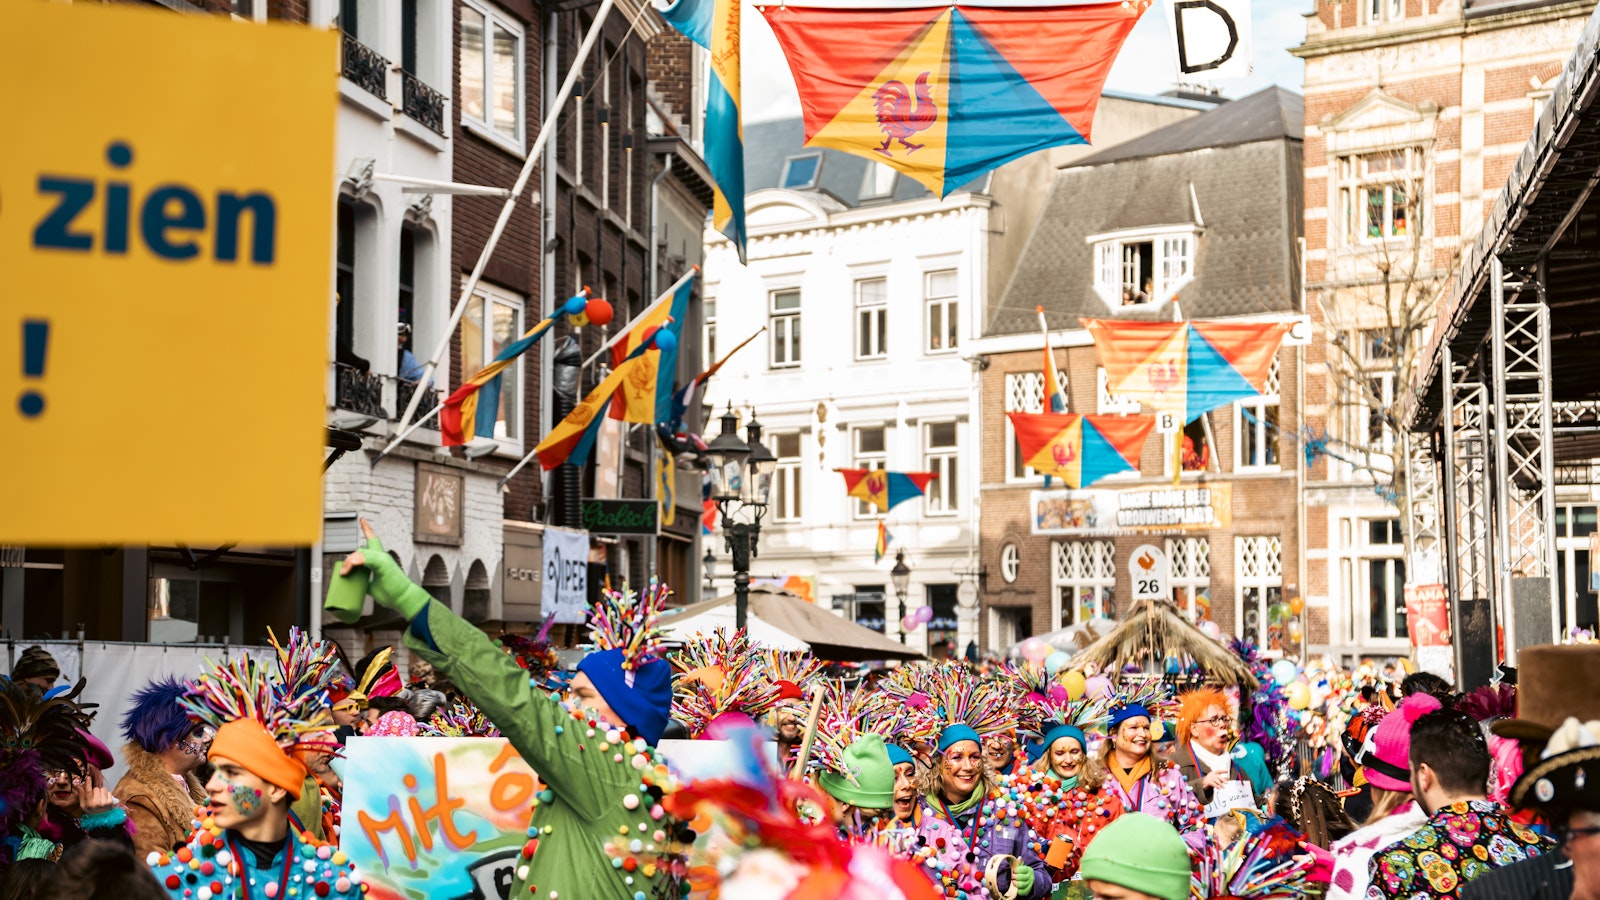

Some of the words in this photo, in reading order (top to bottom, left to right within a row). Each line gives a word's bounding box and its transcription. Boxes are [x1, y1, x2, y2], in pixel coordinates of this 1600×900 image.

[1174, 0, 1239, 74] D
[30, 139, 279, 268] zien
[17, 317, 51, 420] !
[1162, 415, 1173, 429] B
[581, 501, 656, 530] Grolsch
[1138, 579, 1159, 594] 26
